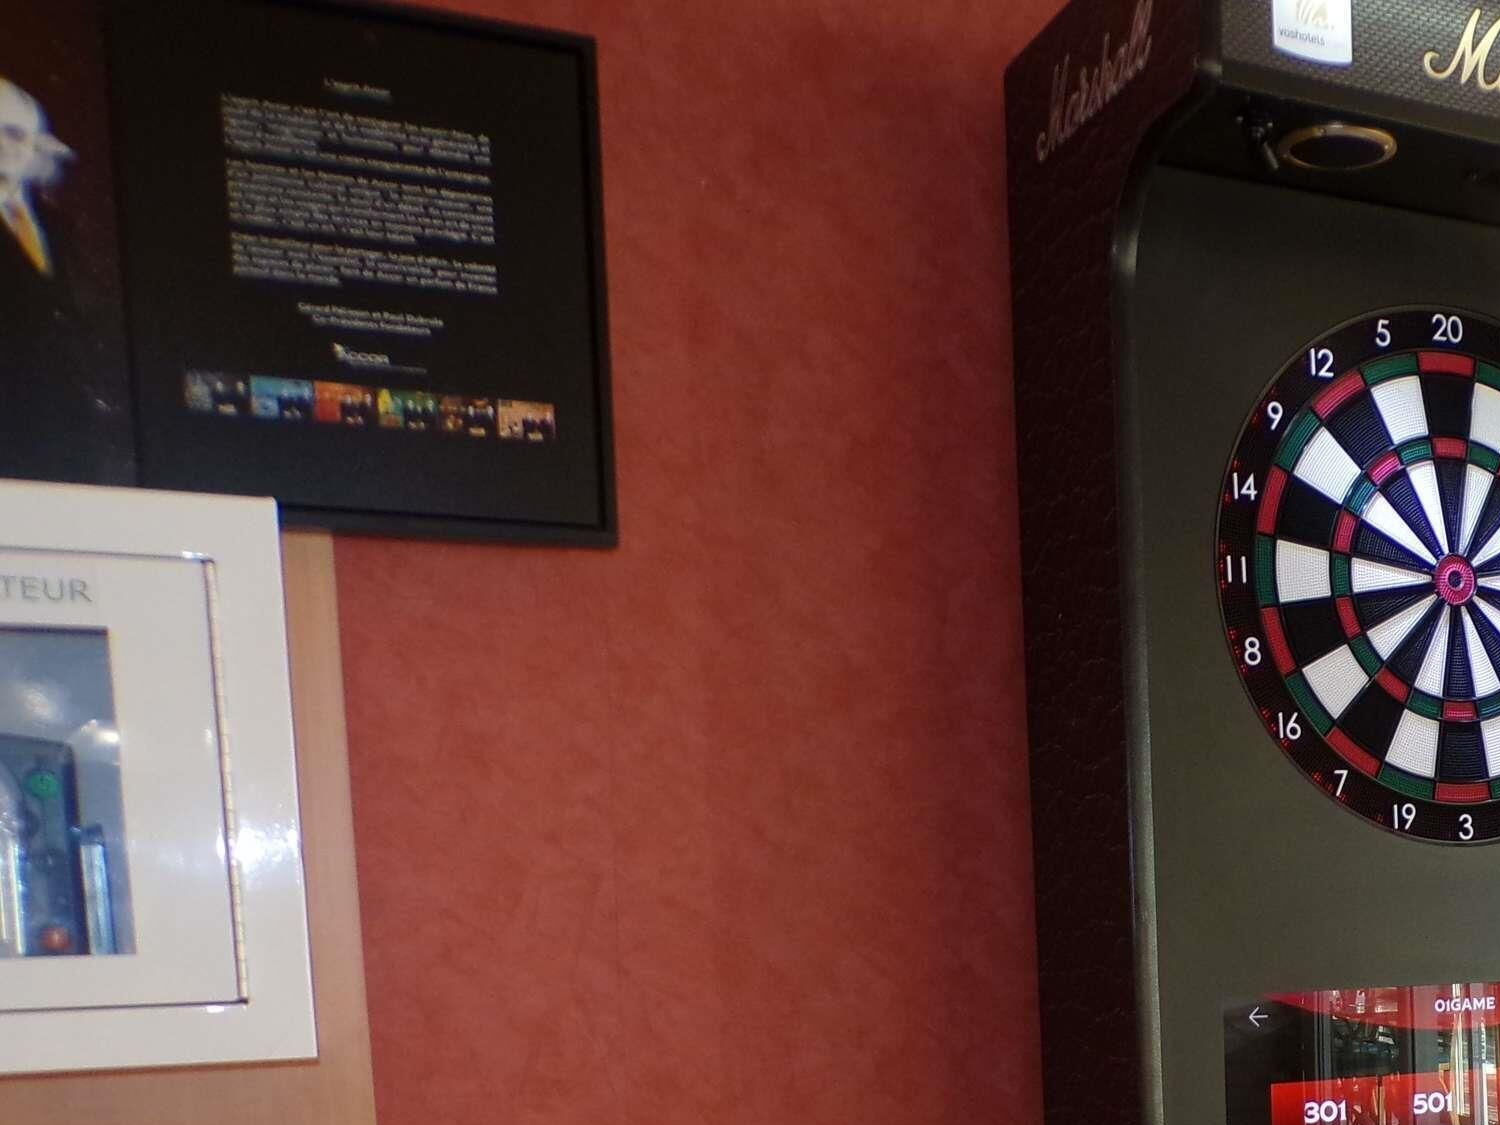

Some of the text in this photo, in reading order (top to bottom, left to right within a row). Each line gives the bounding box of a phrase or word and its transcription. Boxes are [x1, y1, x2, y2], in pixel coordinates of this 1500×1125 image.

[1376, 320, 1390, 346] 5
[1432, 314, 1462, 343] 20
[1310, 348, 1333, 377] 12
[1267, 402, 1283, 427] 9
[1233, 473, 1257, 500] 14
[1227, 555, 1246, 583] 11
[1245, 637, 1261, 663] 8
[1274, 712, 1301, 739] 16
[1334, 770, 1348, 796] 7
[1394, 804, 1416, 829] 19
[1459, 814, 1474, 839] 3
[1304, 1101, 1347, 1124] 301
[1413, 1092, 1454, 1115] 501
